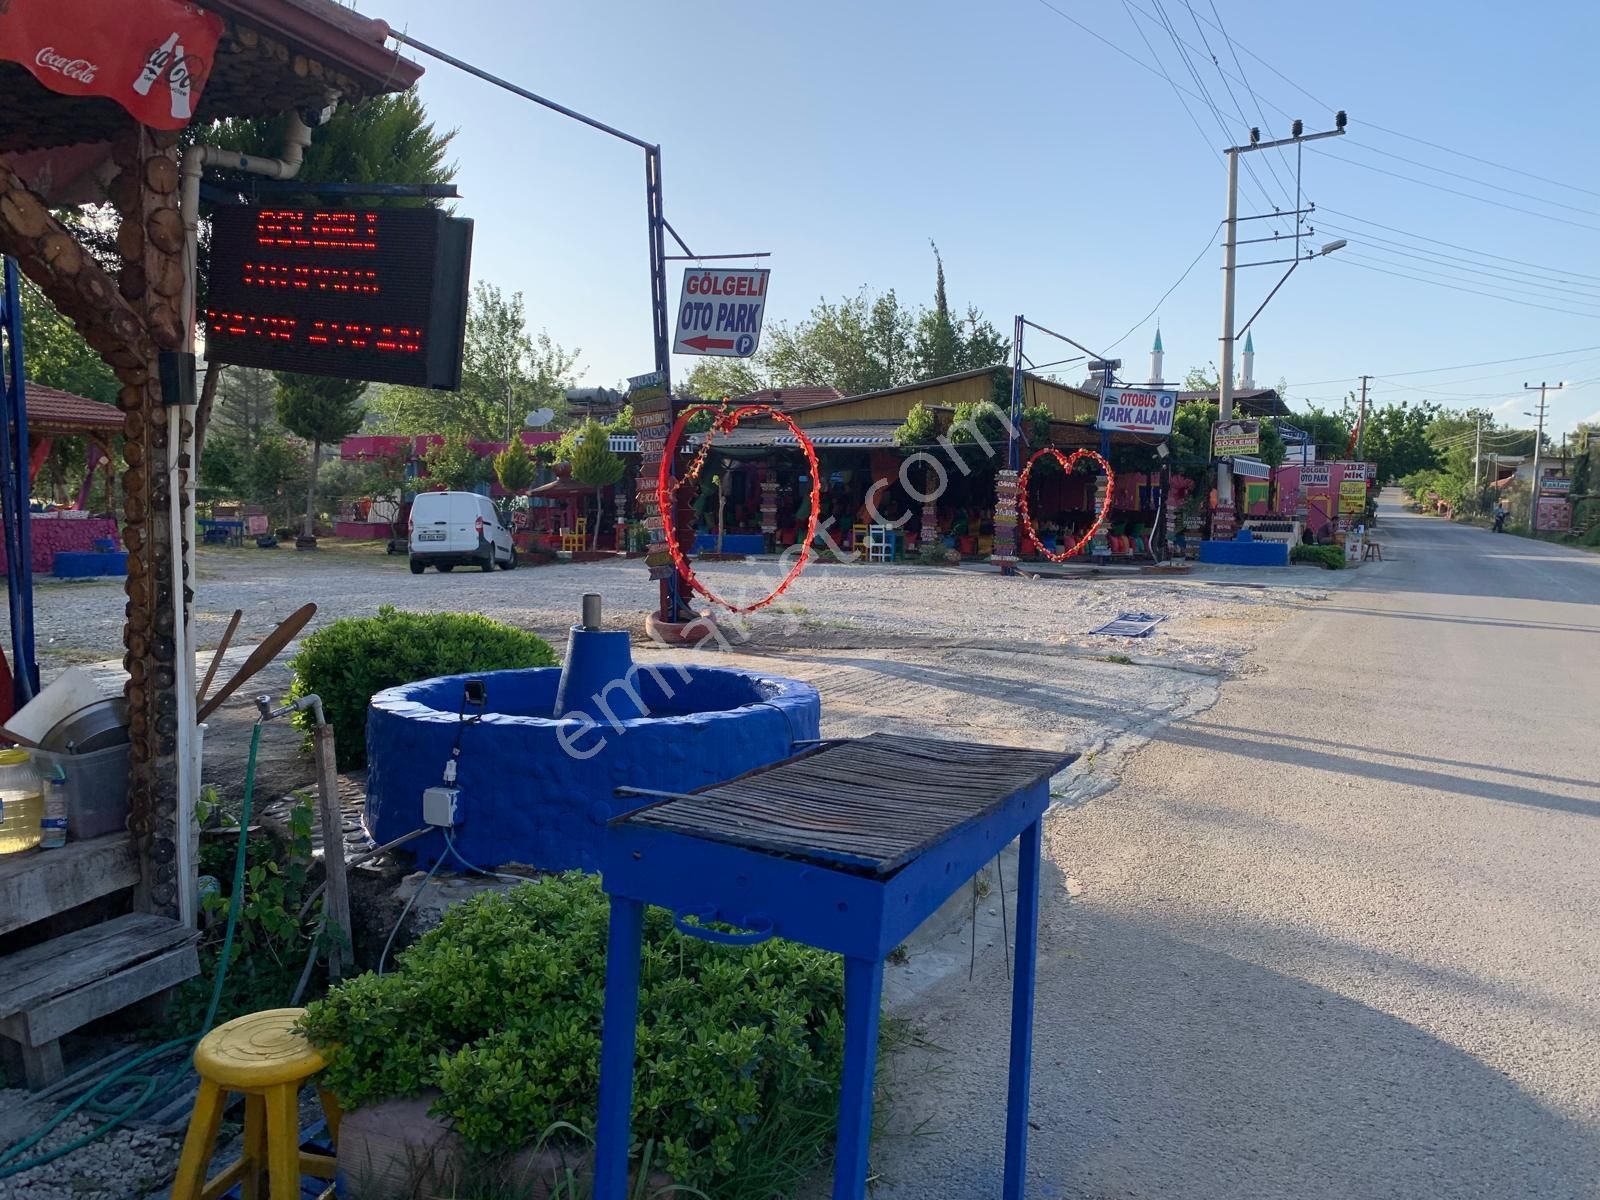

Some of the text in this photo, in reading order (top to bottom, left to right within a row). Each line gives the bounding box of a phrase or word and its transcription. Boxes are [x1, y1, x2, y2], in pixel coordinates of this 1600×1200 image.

[686, 271, 766, 297] GÖLGELİ
[681, 301, 761, 333] OTO PARK
[1120, 392, 1157, 408] OTOBÜS
[1101, 406, 1172, 426] PARK ALANI
[1300, 473, 1329, 483] OTO PARK
